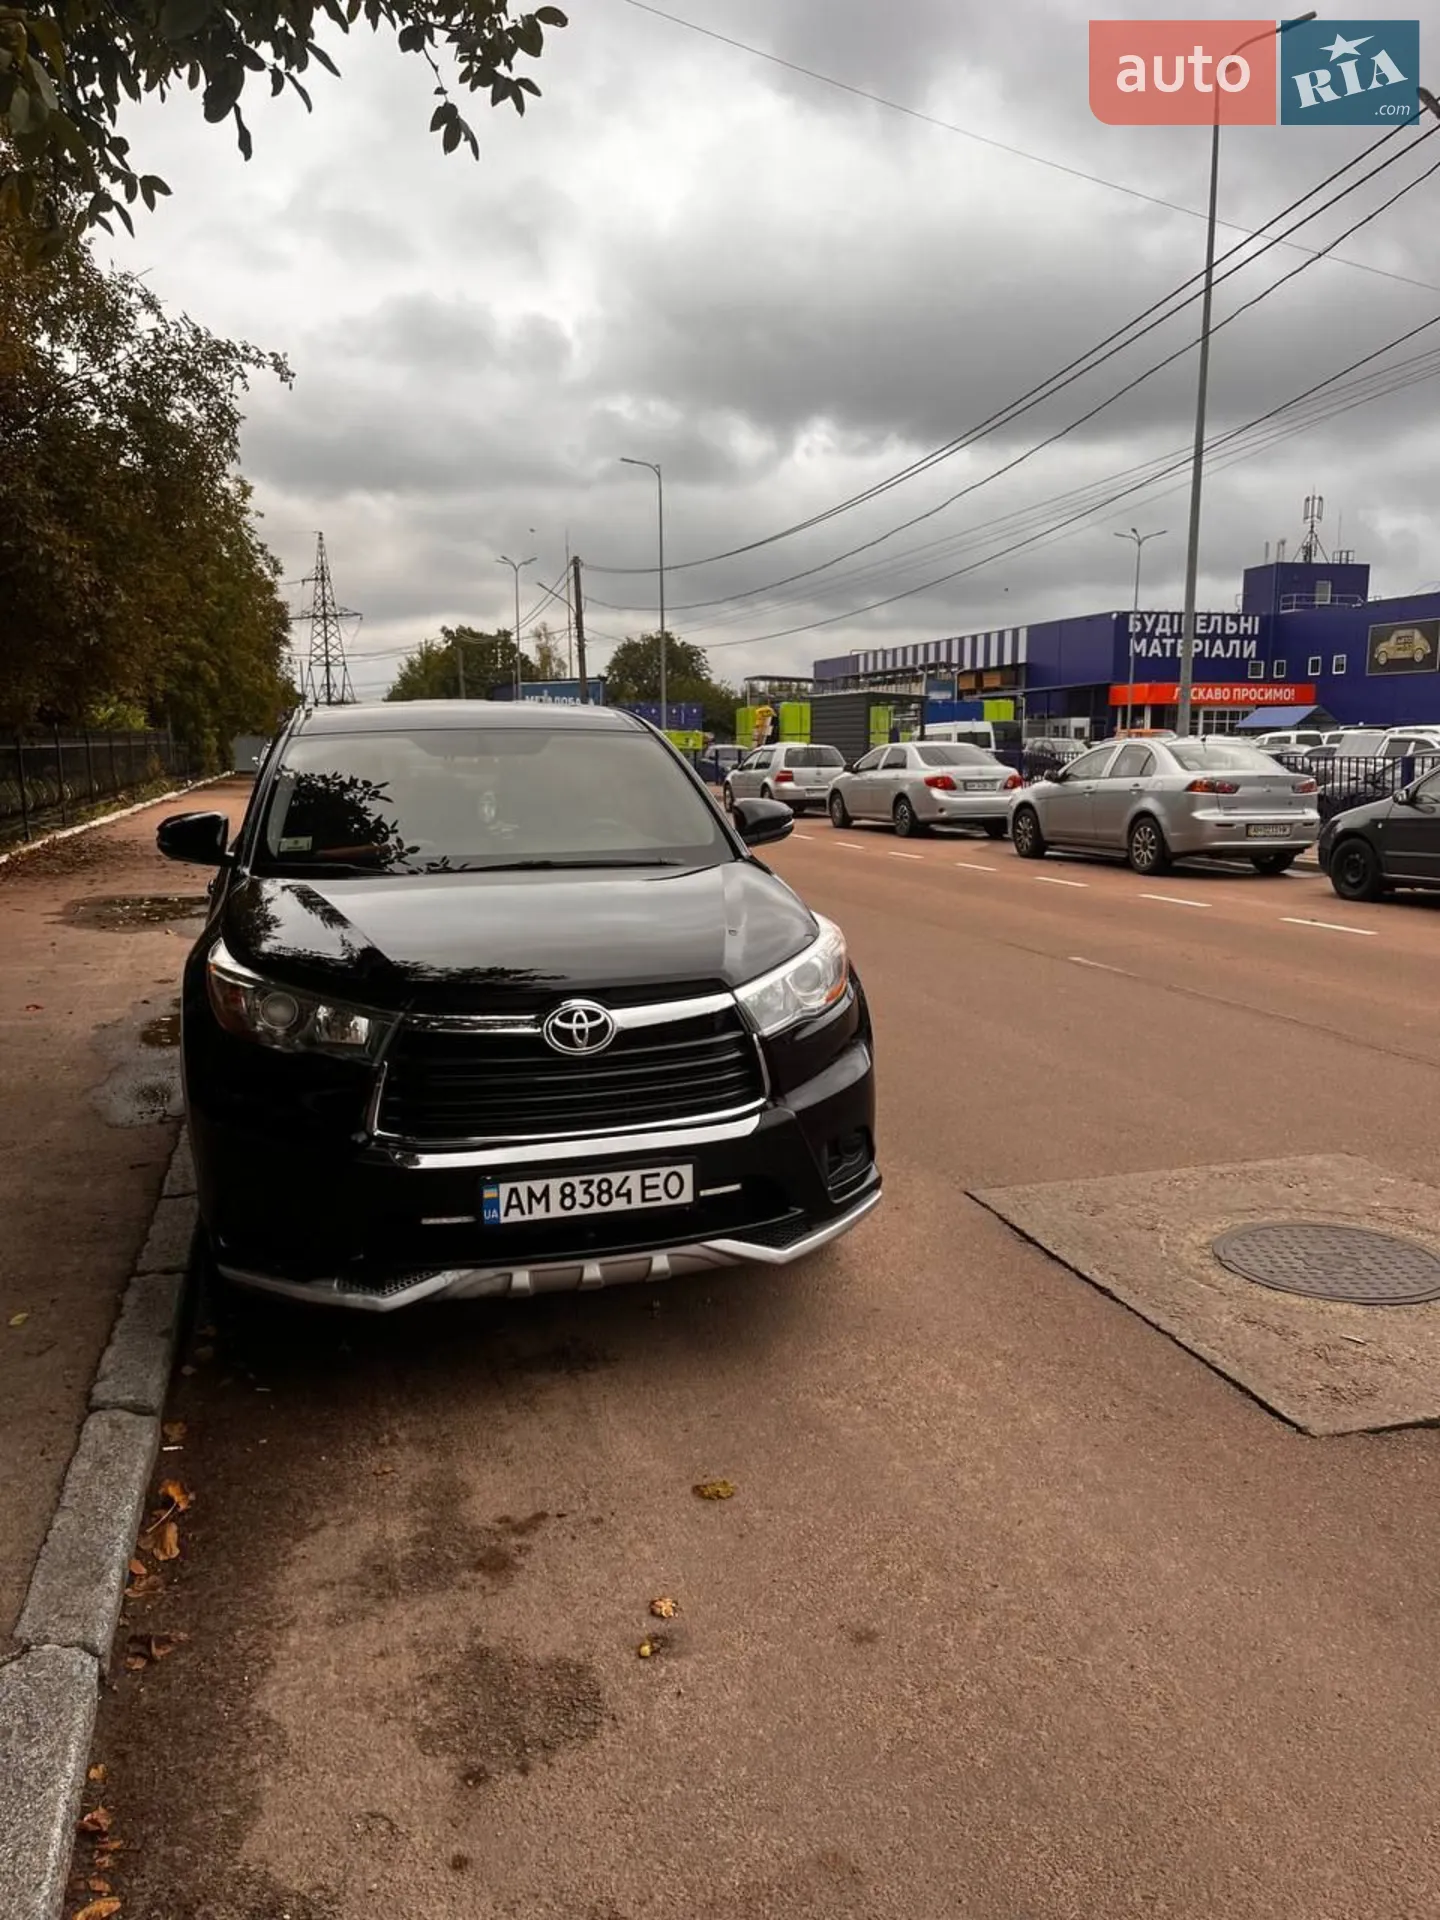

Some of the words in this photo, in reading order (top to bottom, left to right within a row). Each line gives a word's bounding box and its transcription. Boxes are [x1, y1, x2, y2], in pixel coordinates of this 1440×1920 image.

[1128, 614, 1260, 636] БУДІЕЛЬНІ
[1173, 687, 1231, 700] ЛСКАВО
[1233, 687, 1295, 700] ПРОСИМО!
[484, 1210, 499, 1220] UA
[503, 1184, 550, 1217] AM
[559, 1175, 632, 1211] 8384
[640, 1171, 684, 1203] EO
